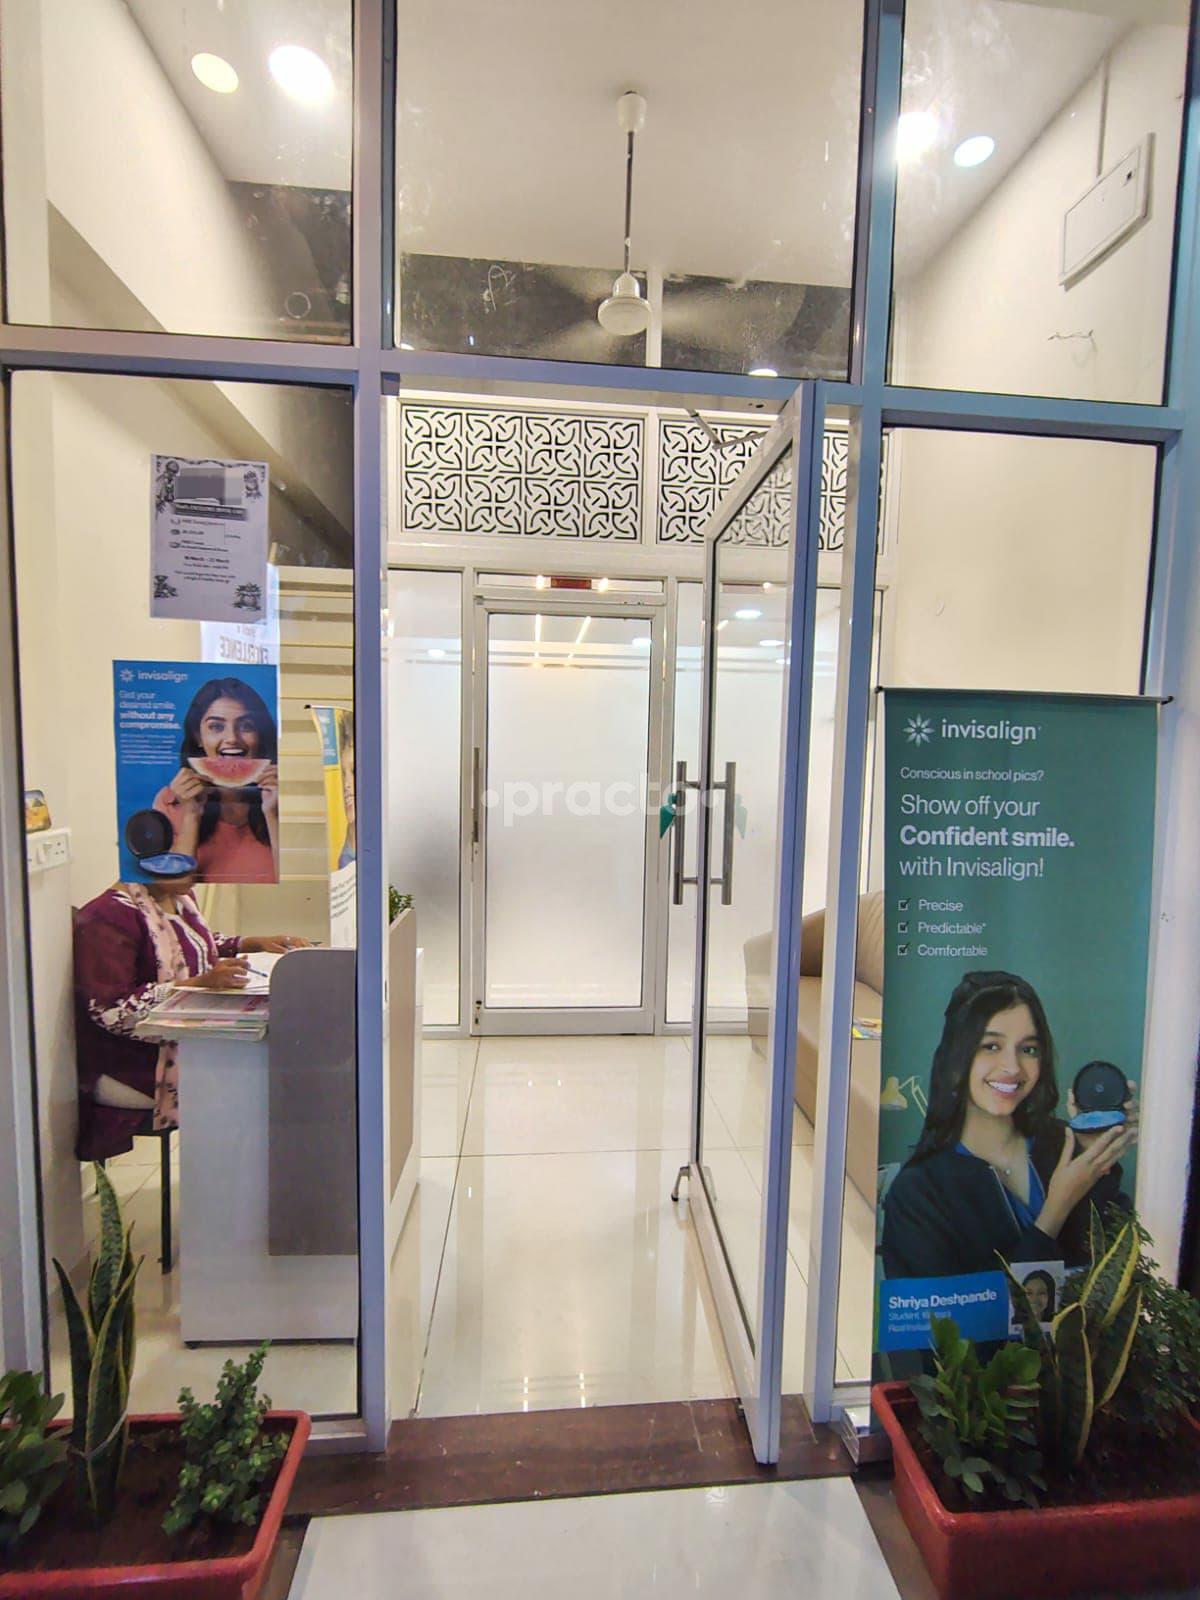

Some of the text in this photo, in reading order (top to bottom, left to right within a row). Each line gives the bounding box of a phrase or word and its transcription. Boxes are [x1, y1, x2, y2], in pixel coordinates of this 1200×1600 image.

[138, 670, 188, 683] invisalign
[941, 719, 1037, 745] invisalign
[900, 767, 1043, 784] Conscious in school pics?
[900, 794, 1040, 820] Show off your
[900, 825, 1075, 847] Confident smile.
[900, 857, 1044, 882] with Invisalign!
[918, 899, 964, 911] Precise
[917, 944, 988, 957] Comfortable
[889, 1288, 997, 1310] Shriya Deshpande
